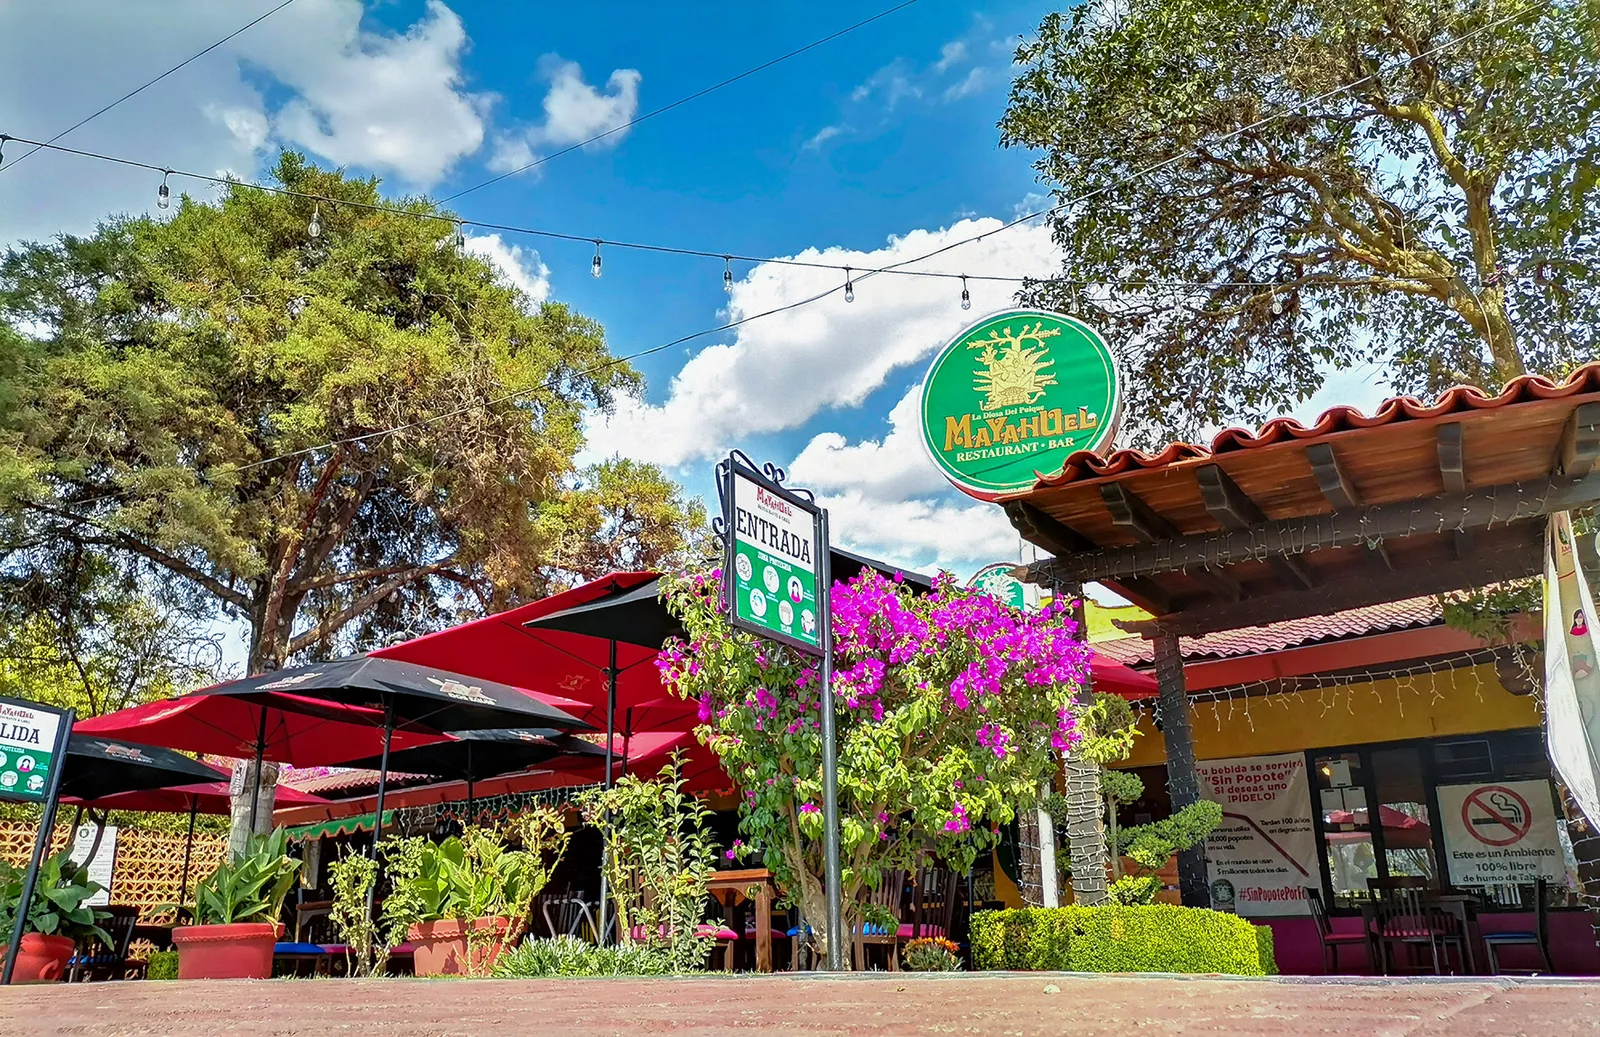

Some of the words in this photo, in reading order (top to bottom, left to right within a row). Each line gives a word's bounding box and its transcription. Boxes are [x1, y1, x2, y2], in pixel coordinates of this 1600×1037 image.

[983, 411, 1004, 419] Diosa
[1005, 408, 1018, 416] Del
[956, 442, 1040, 463] RESTAURANT
[1048, 437, 1075, 450] BAR
[736, 506, 812, 565] ENTRADA
[1210, 765, 1247, 775] bebida
[1250, 764, 1262, 772] se
[1227, 785, 1264, 794] deseas
[1267, 782, 1288, 791] uno
[1281, 817, 1293, 825] 100
[1452, 851, 1475, 860] Este
[1475, 851, 1488, 859] es
[1488, 850, 1502, 858] un
[1503, 848, 1557, 858] Ambiente
[1475, 863, 1509, 872] 100%
[1509, 862, 1537, 871] libre
[1463, 874, 1476, 882] de
[1505, 873, 1519, 881] de
